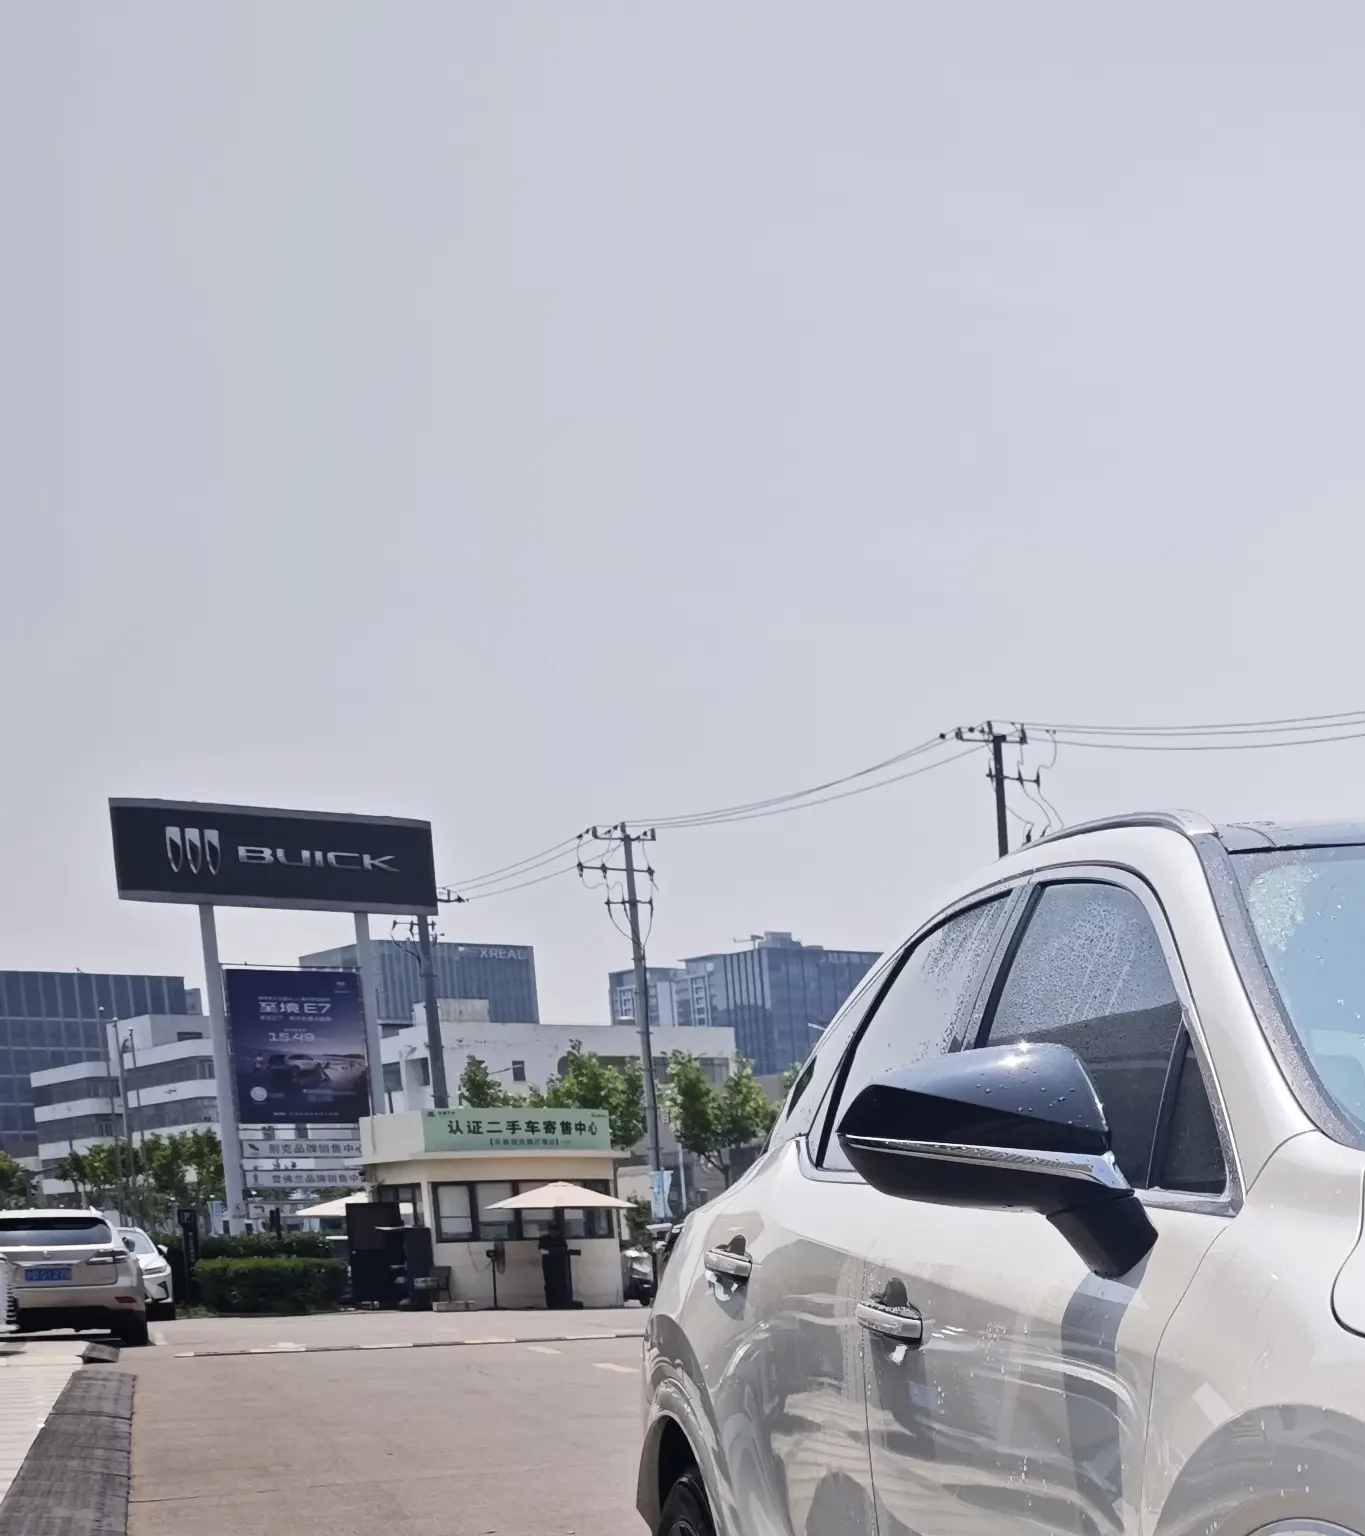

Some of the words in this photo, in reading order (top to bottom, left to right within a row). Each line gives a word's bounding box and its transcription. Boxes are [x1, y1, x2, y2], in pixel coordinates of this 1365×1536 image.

[238, 845, 400, 872] BUICK
[480, 947, 526, 960] XREAL
[303, 1002, 331, 1014] E7
[448, 1119, 598, 1136] 认证二手车寄售中心
